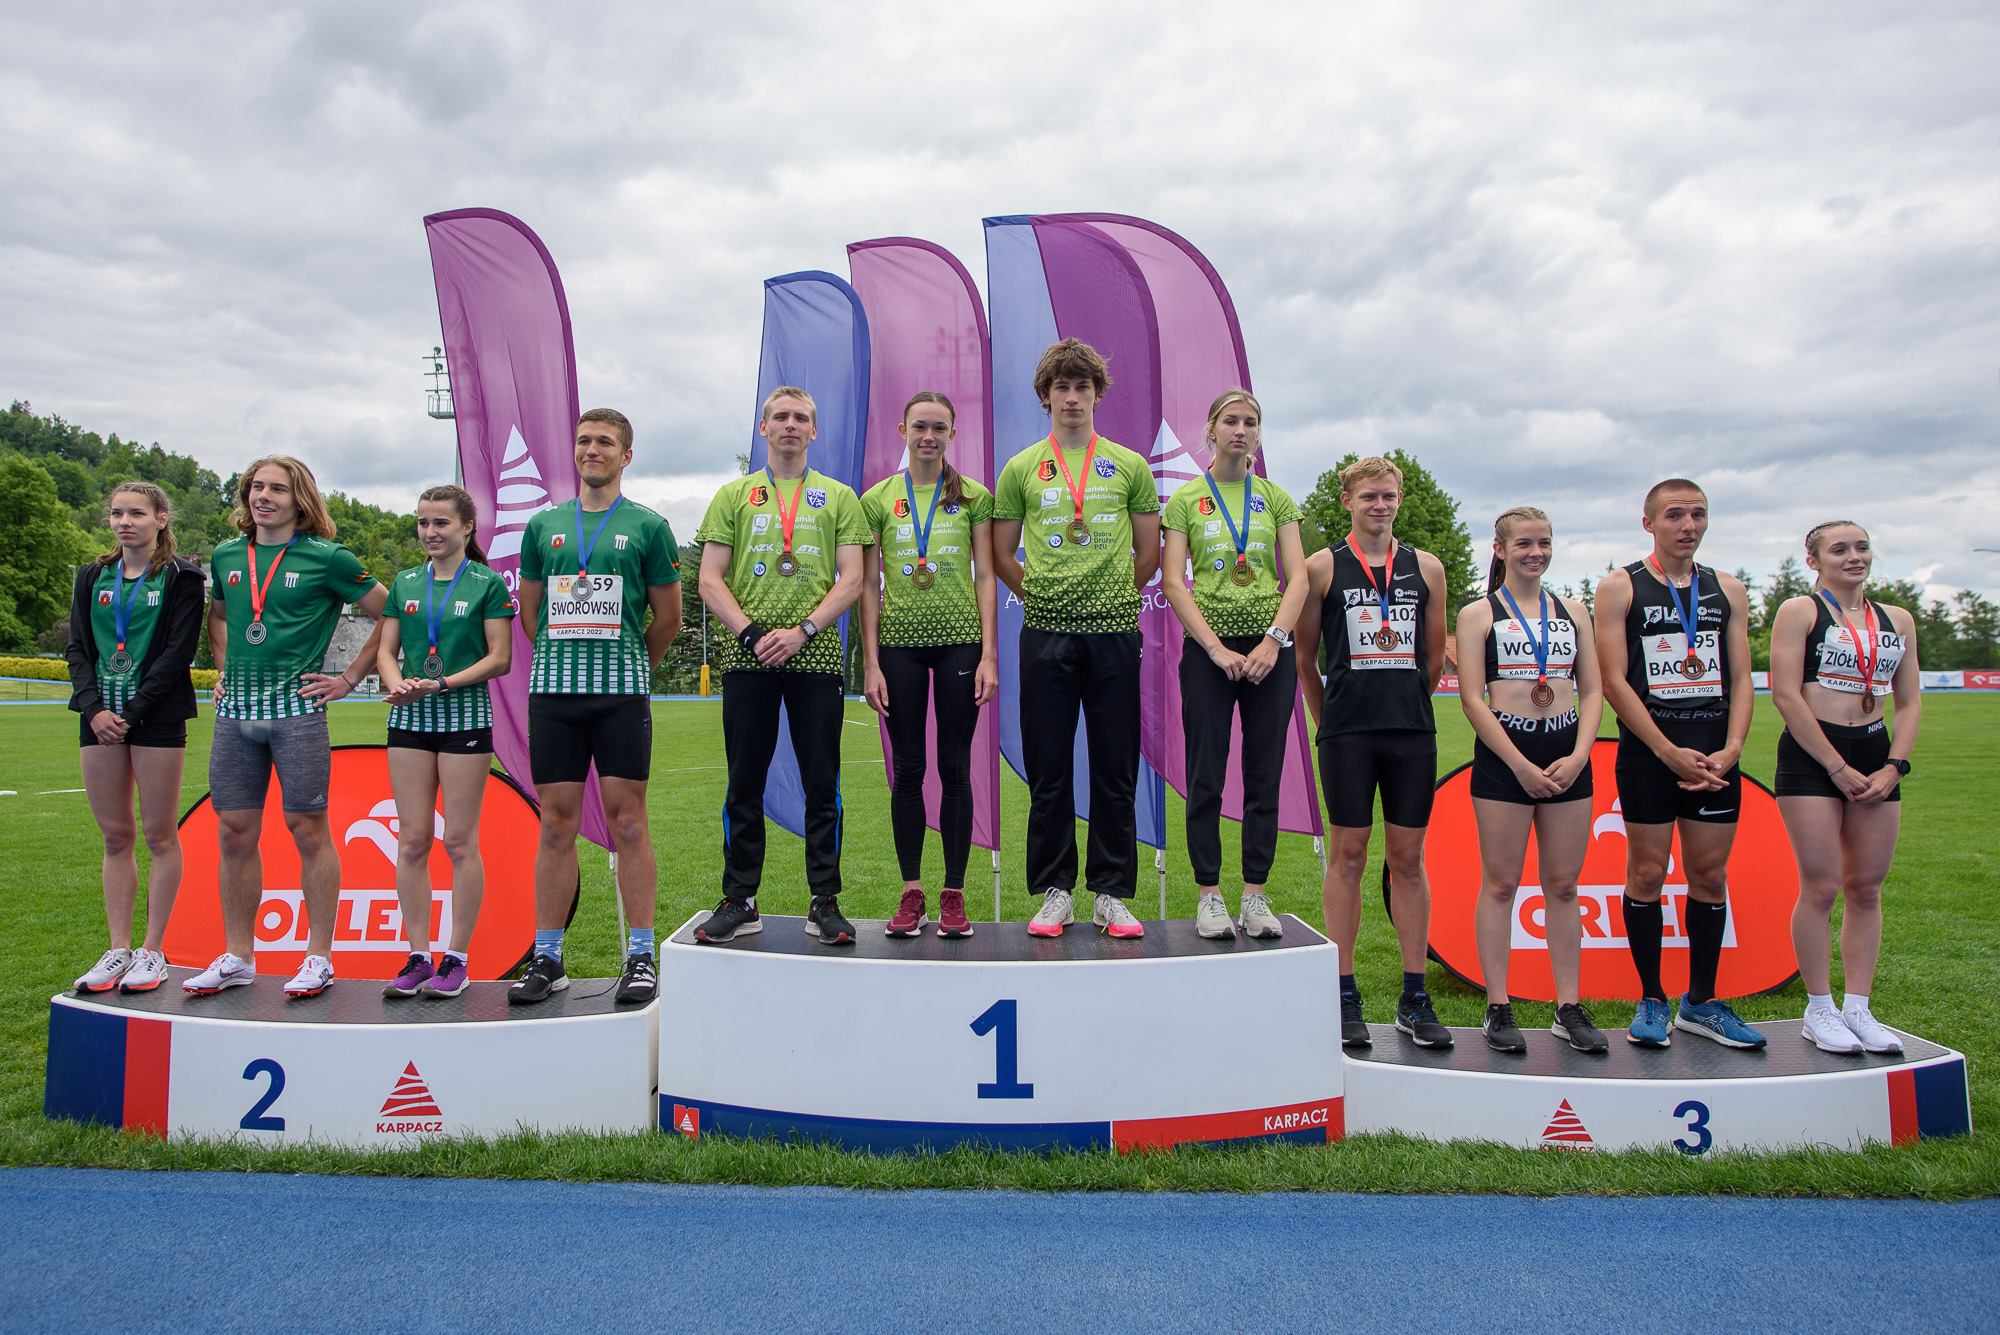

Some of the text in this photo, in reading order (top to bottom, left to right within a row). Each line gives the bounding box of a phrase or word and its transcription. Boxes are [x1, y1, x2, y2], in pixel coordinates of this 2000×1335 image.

[1042, 515, 1068, 526] MZK
[794, 524, 824, 534] półdzielczy
[748, 544, 774, 552] MZK
[896, 548, 919, 557] MZK
[1206, 542, 1228, 554] MZK
[592, 578, 614, 592] 59
[552, 601, 619, 616] SWOROWSKI
[1390, 608, 1416, 622] 102
[557, 628, 585, 636] KARPACZ
[1358, 631, 1413, 646] ŁYAK
[1695, 634, 1714, 648] 95
[1503, 642, 1572, 656] WOTAS
[1827, 678, 1864, 690] KARPACZ
[1498, 708, 1578, 732] PRO NIKE
[1648, 708, 1692, 718] NIKE
[969, 999, 1034, 1099] 1
[240, 1058, 286, 1132] 2
[1264, 1108, 1328, 1131] KARPACZ
[376, 1122, 442, 1133] KARPACZ
[1672, 1100, 1712, 1156] 3
